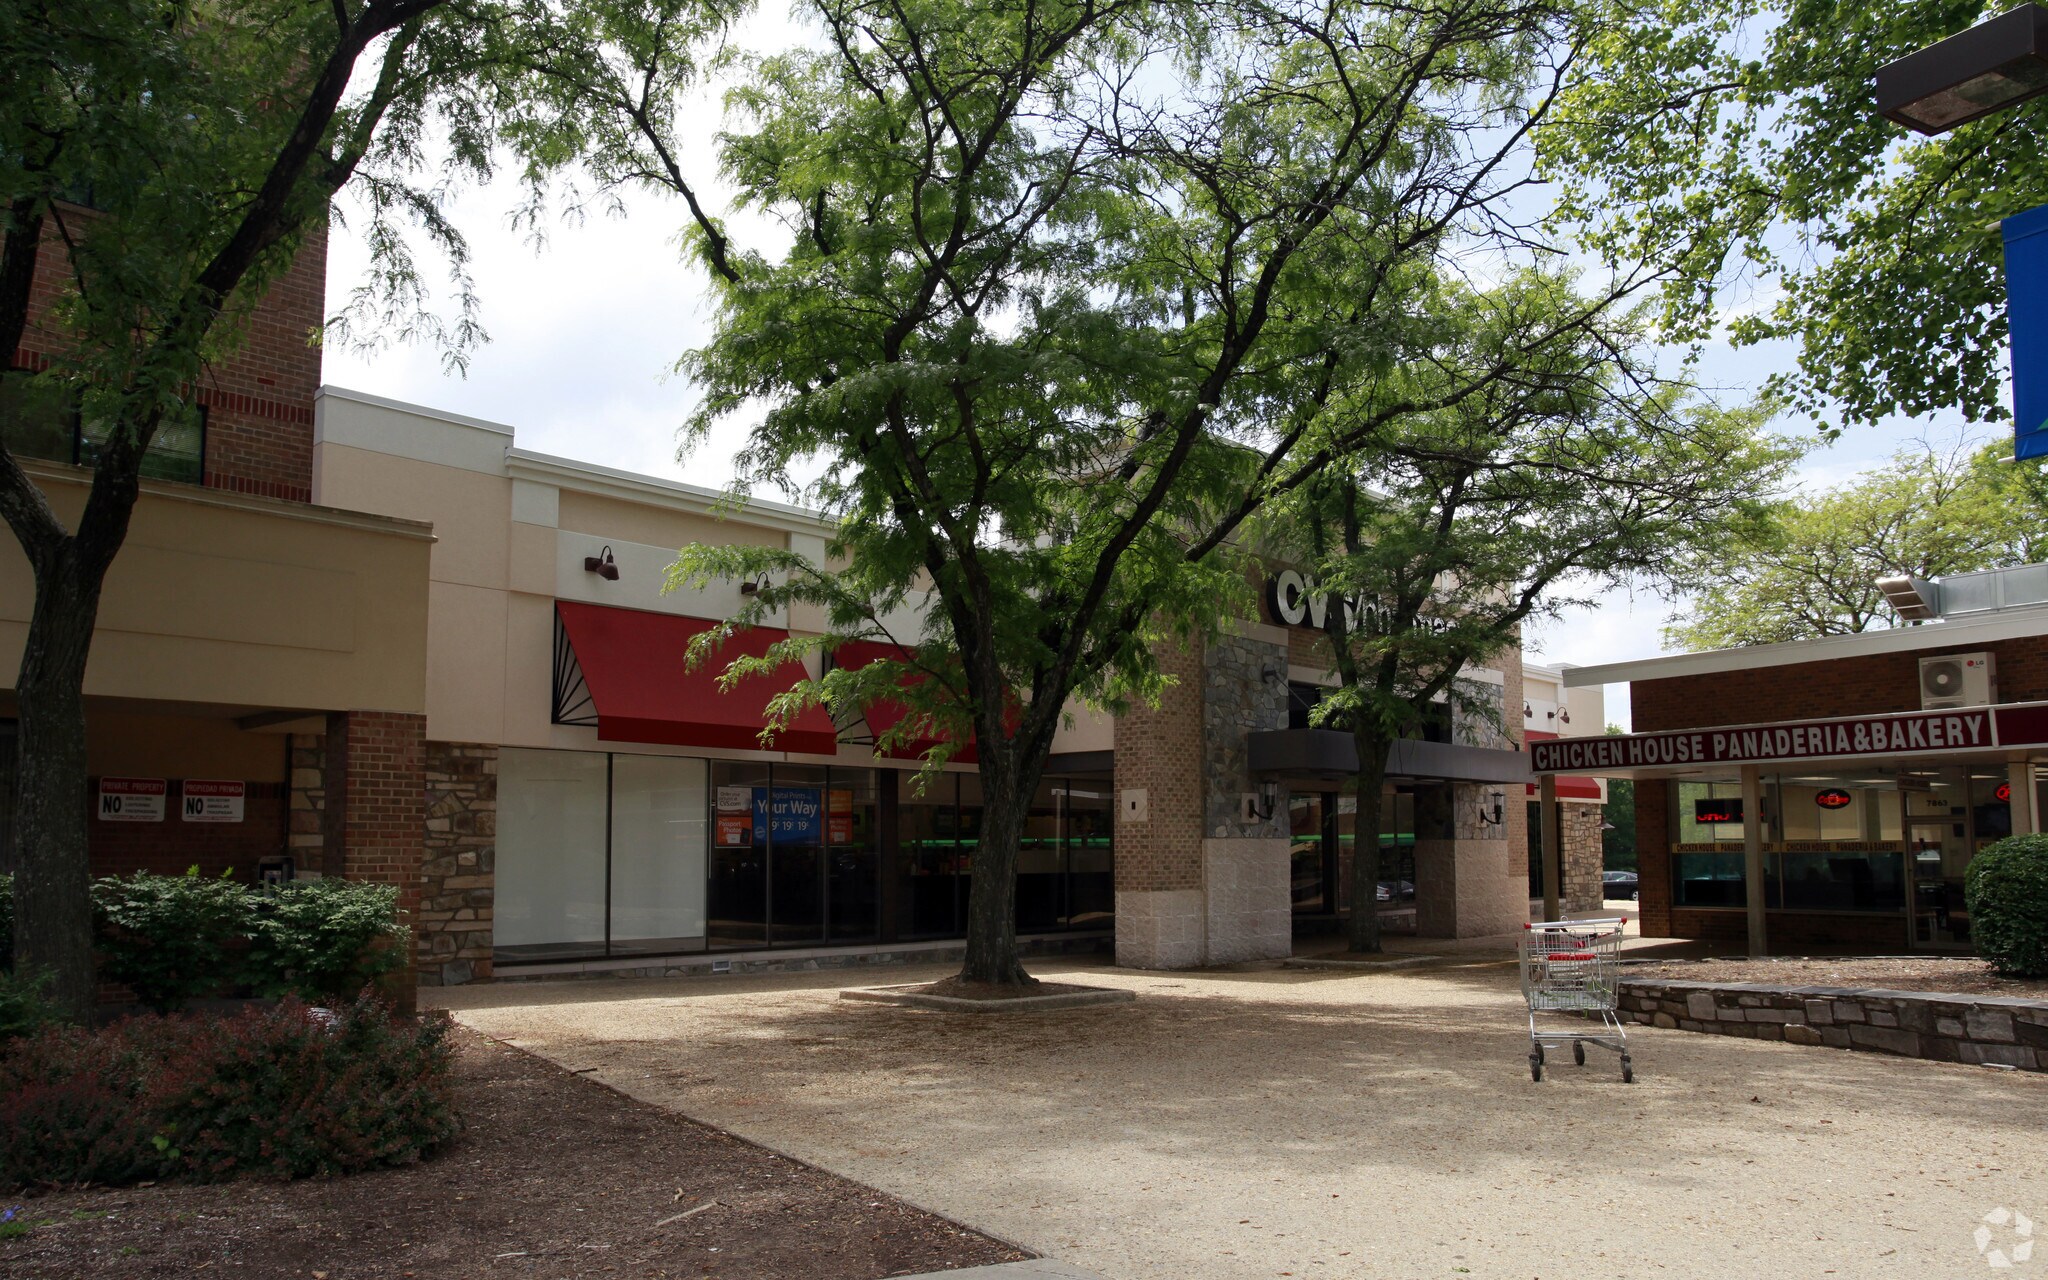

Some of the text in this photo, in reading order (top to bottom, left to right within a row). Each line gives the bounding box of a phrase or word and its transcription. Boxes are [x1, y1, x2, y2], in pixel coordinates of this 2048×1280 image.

[1535, 741, 1623, 770] CHICKEN
[1629, 735, 1704, 764] HOUSE
[102, 781, 165, 792] PRIVATE PROPERTY
[186, 784, 243, 793] PROPIEDAD PRIVADA
[772, 792, 788, 800] igital
[103, 795, 122, 813] NO
[186, 797, 204, 815] NO
[1926, 799, 1948, 807] 7863
[790, 800, 817, 818] Way
[1676, 843, 1698, 852] CHICKEN
[1699, 843, 1715, 852] HOUSE
[1720, 842, 1744, 852] PANADER
[1786, 842, 1811, 852] CHICKEN
[1811, 842, 1830, 852] HOUSE
[1836, 842, 1868, 851] PANADERIA
[1873, 842, 1897, 851] BAKERY
